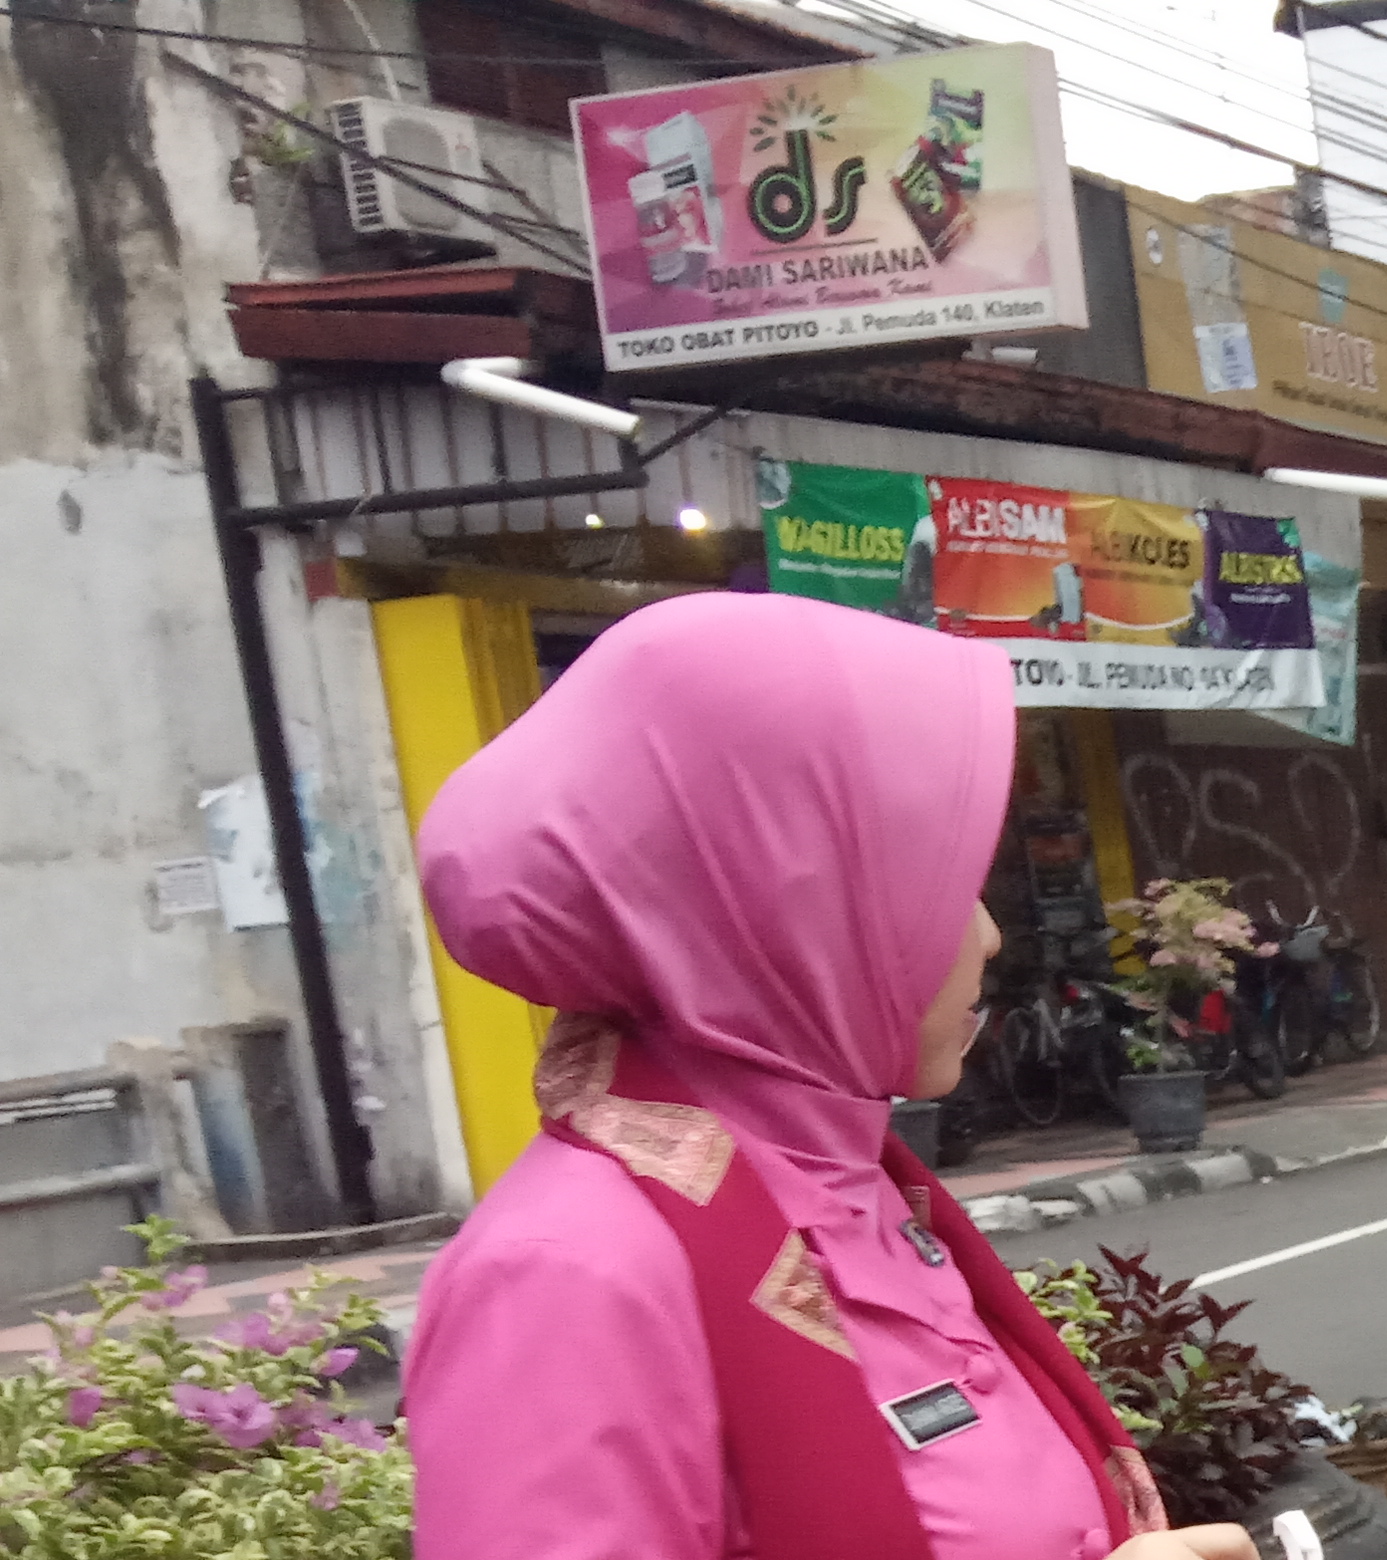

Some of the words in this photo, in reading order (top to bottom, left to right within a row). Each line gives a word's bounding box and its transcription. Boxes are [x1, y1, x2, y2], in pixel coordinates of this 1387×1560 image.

[706, 264, 772, 294] DAMI
[782, 246, 930, 285] SARIWANA
[618, 338, 673, 359] TOKO
[681, 328, 734, 353] OBAT
[743, 321, 819, 347] PITOYO
[862, 307, 936, 331] Pemuda
[984, 298, 1045, 320] Klaten
